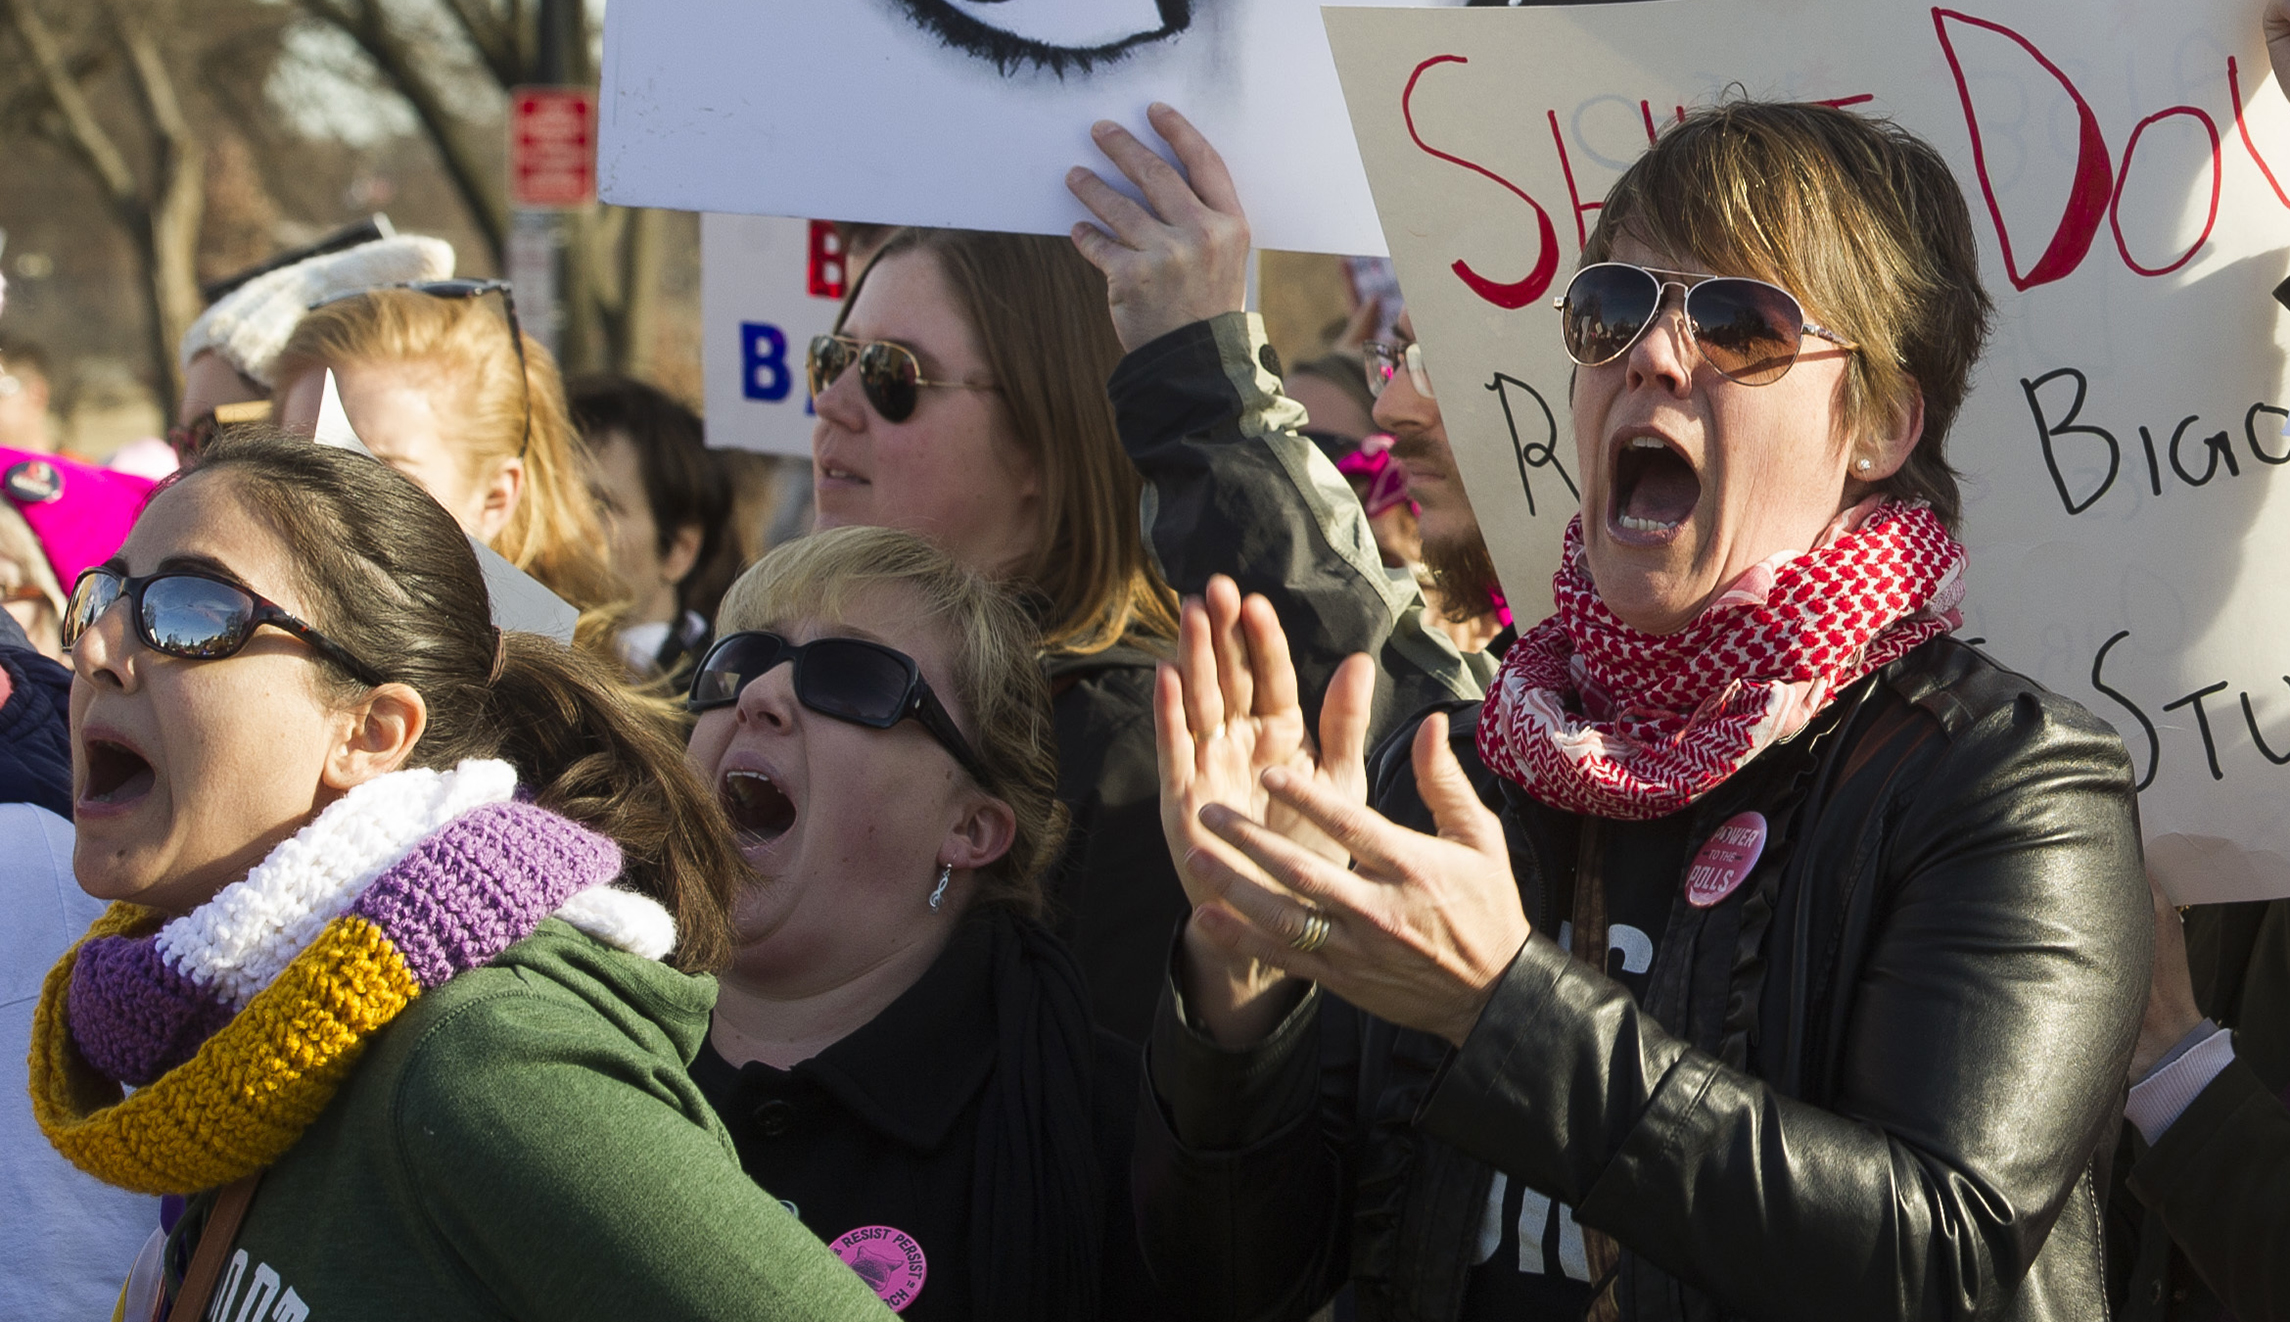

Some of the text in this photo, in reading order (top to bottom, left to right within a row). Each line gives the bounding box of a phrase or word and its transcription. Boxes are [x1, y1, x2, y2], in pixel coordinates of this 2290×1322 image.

[1710, 825, 1759, 848] POWER
[1708, 849, 1736, 863] TO THE
[1685, 864, 1735, 893] POLLS
[840, 1227, 923, 1280] RESIST PERSIST
